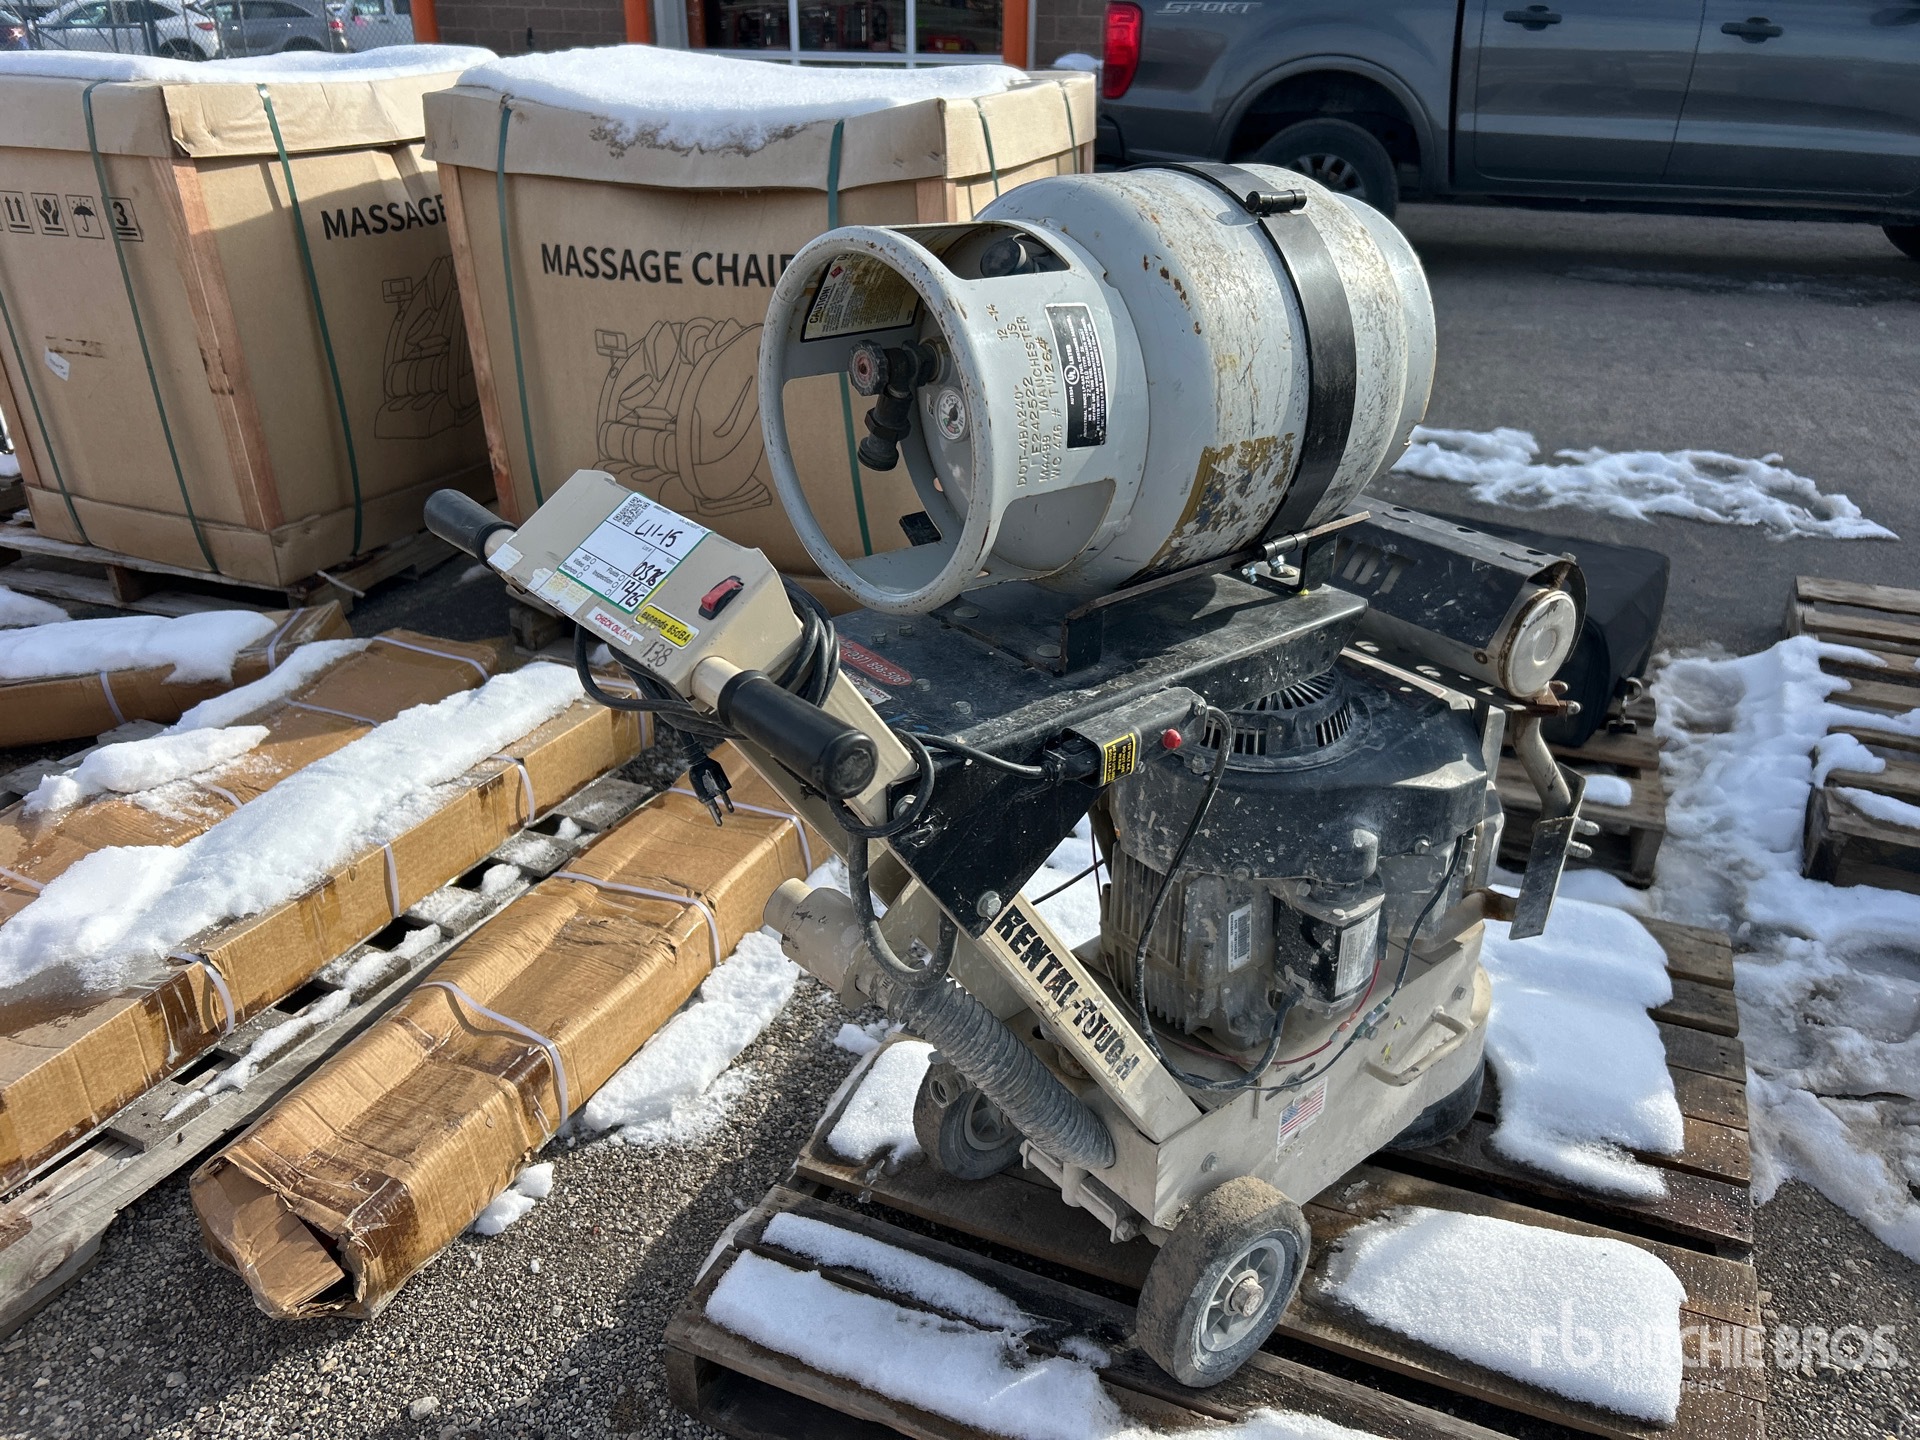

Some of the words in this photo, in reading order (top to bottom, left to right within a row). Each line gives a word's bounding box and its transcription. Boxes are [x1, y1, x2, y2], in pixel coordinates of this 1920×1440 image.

[1155, 2, 1262, 15] SPORT
[112, 202, 128, 226] 3
[541, 243, 683, 284] MASSAGE
[1016, 316, 1049, 412] MANCHESTER
[595, 613, 612, 628] CHECK
[611, 624, 620, 634] OIL
